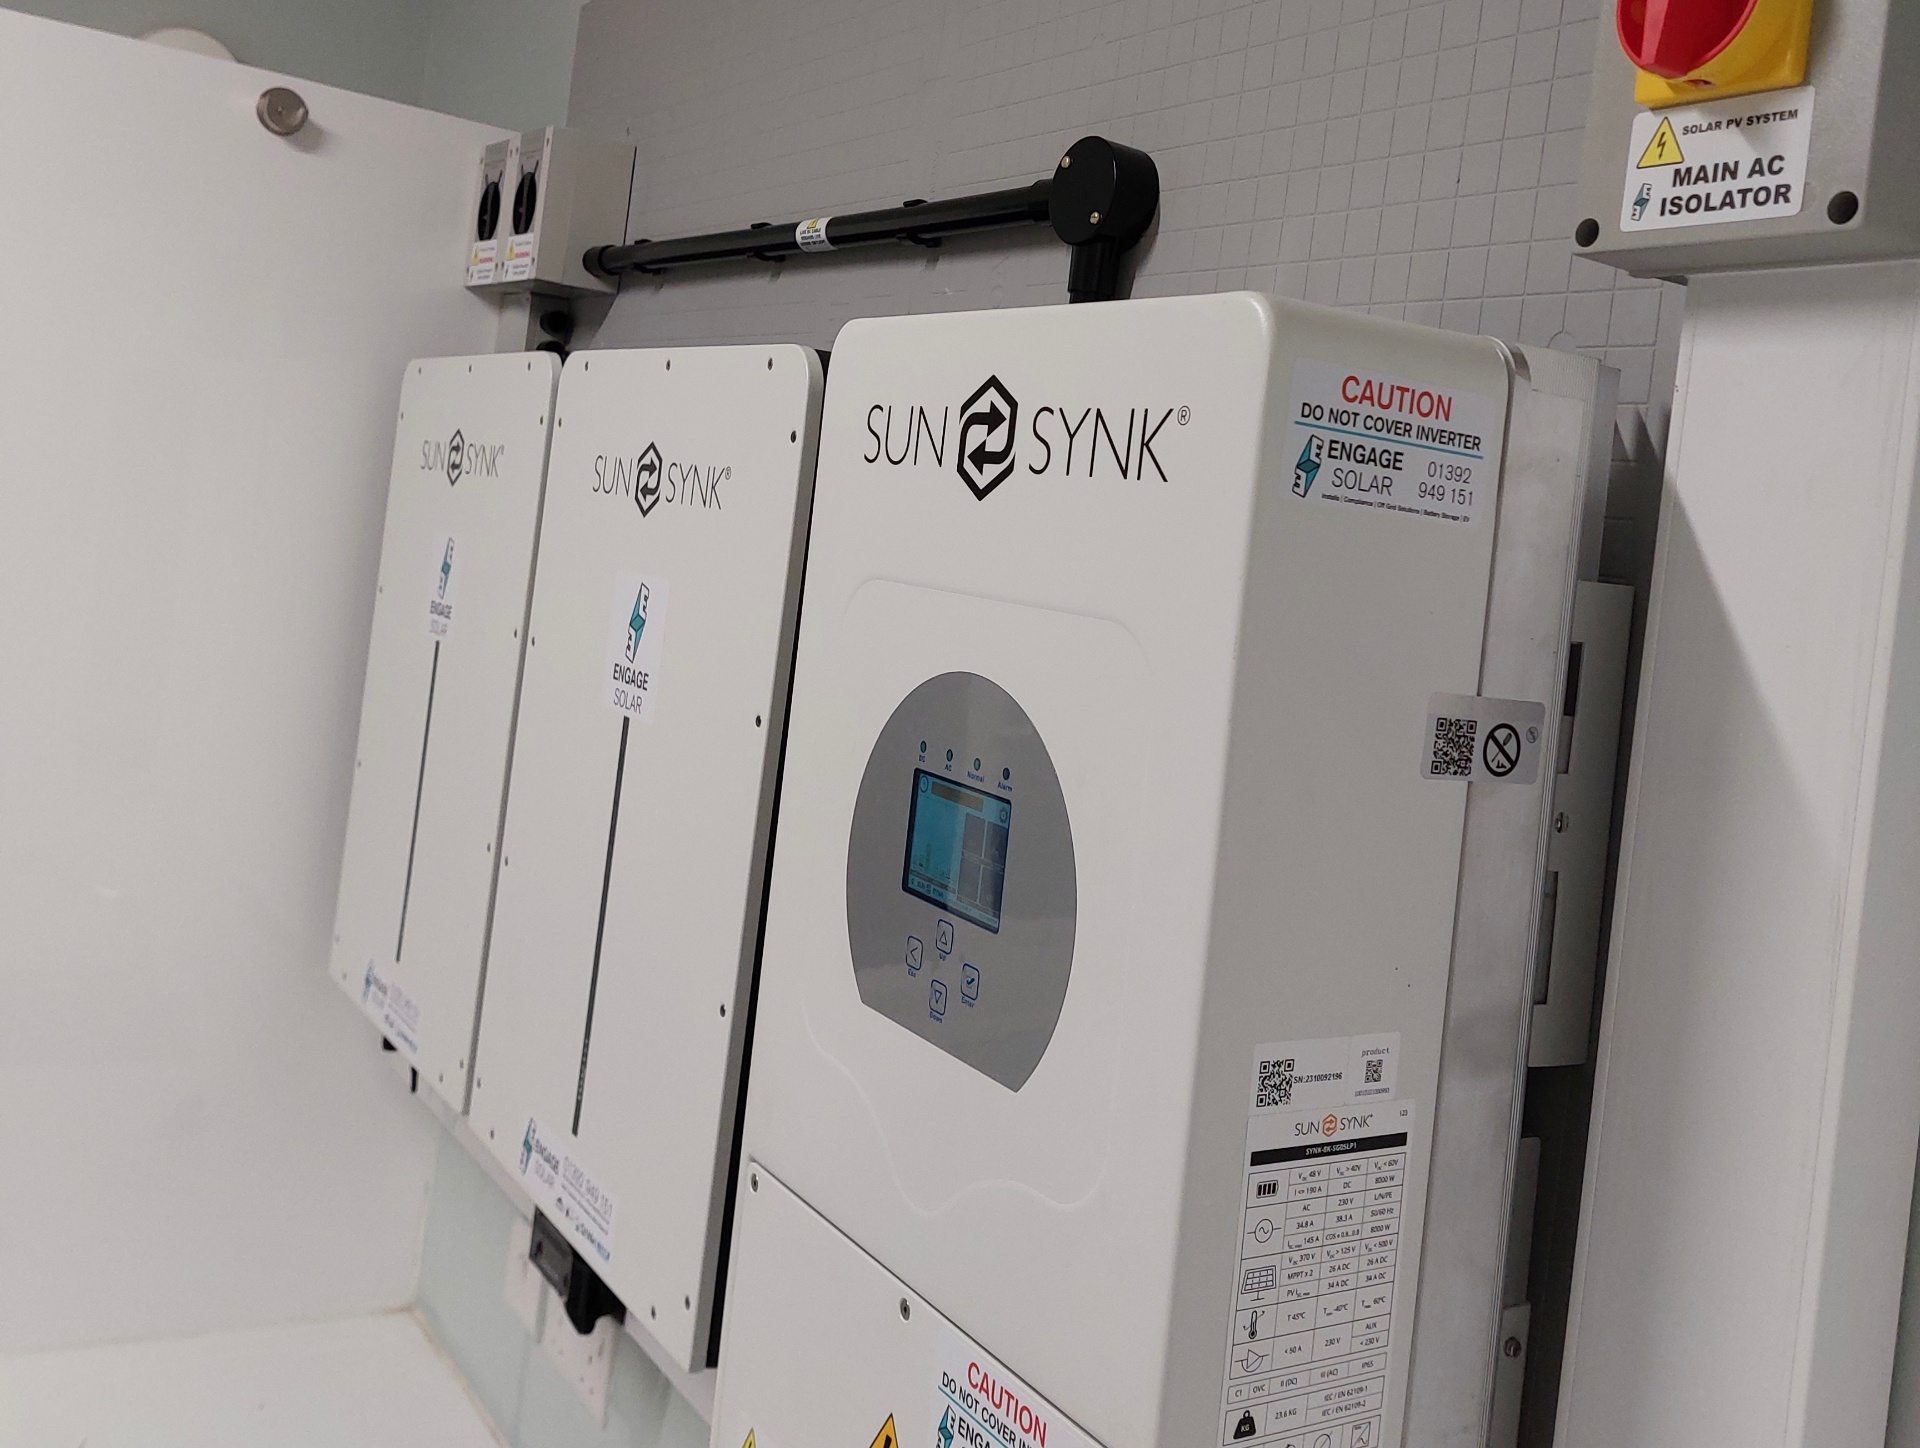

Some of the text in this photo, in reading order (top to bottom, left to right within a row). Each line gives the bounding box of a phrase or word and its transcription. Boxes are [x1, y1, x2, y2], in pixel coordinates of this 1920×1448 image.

[1682, 109, 1799, 135] SOLAR PV SYSTEM
[1672, 155, 1785, 188] MAIN AC
[1660, 184, 1793, 216] ISOLATOR
[1341, 375, 1452, 422] CAUTION
[863, 404, 949, 468] SUN
[1301, 402, 1482, 451] DO NOT COVER INVERTER
[420, 439, 447, 472] SUN
[1327, 439, 1404, 471] ENGAGE
[593, 455, 633, 497] SUN
[1331, 467, 1393, 496] SOLAR
[1427, 461, 1472, 484] 01392
[1418, 481, 1474, 506] 949 151
[613, 662, 649, 692] ENGAGE
[613, 687, 643, 714] SOLAR
[944, 763, 952, 772] AC
[967, 771, 985, 783] Normal
[997, 781, 1013, 792] Alarm
[1361, 1047, 1390, 1058] product
[1294, 1121, 1320, 1136] SUN
[1365, 1322, 1377, 1330] AUX
[1252, 1384, 1266, 1394] OVC
[1338, 1390, 1346, 1398] EN
[942, 1371, 1017, 1448] DO NOT COVER
[968, 1362, 1047, 1448] CAUTION
[1288, 1408, 1297, 1417] KG
[1335, 1405, 1343, 1414] EN
[1241, 1424, 1250, 1432] KG
